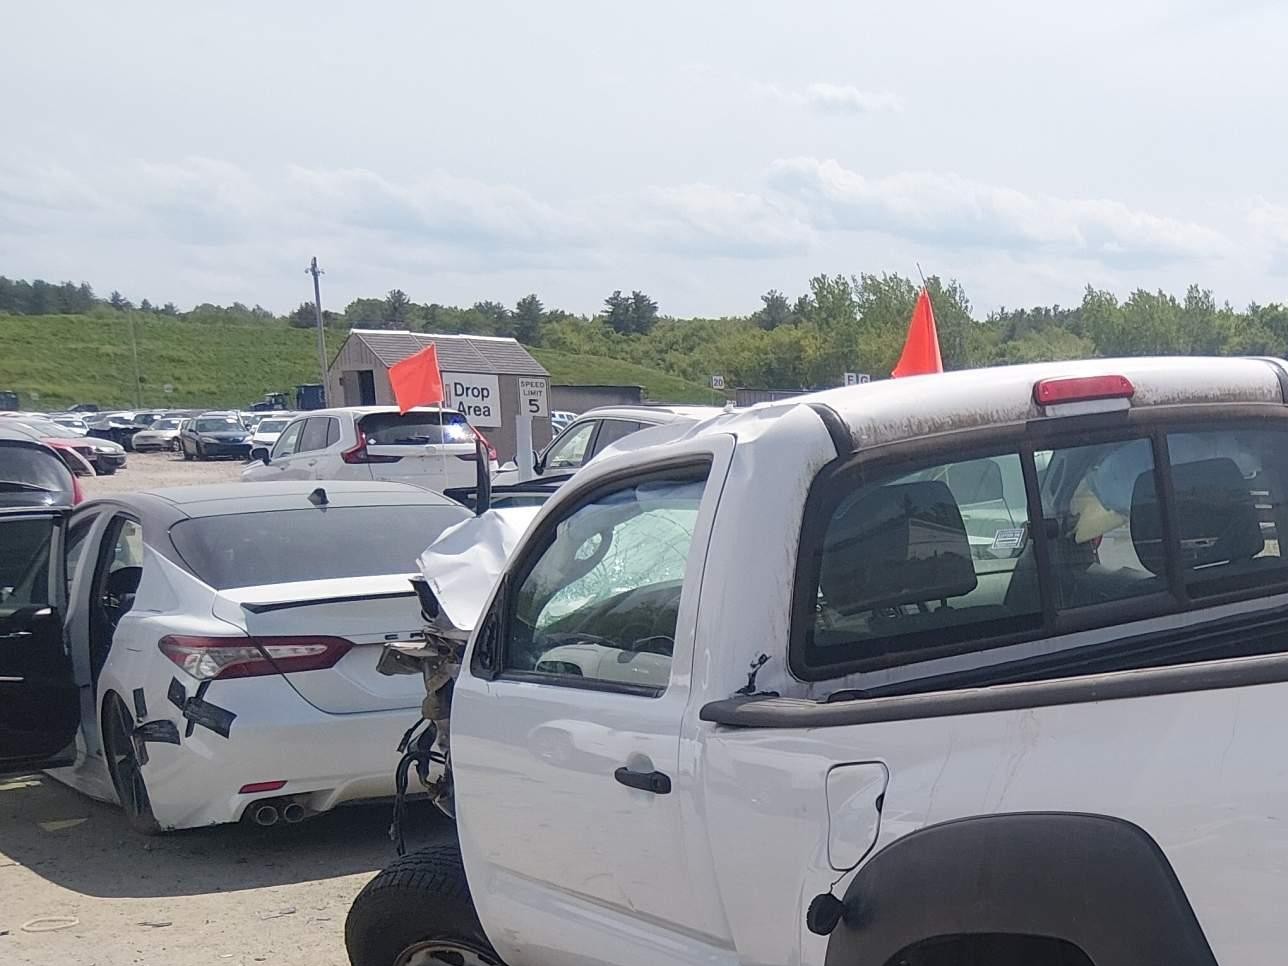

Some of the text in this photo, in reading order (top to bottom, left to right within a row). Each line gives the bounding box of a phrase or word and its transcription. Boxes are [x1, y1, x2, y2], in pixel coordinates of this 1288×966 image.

[454, 382, 490, 401] Drop
[457, 401, 491, 416] Area
[528, 398, 540, 413] 5
